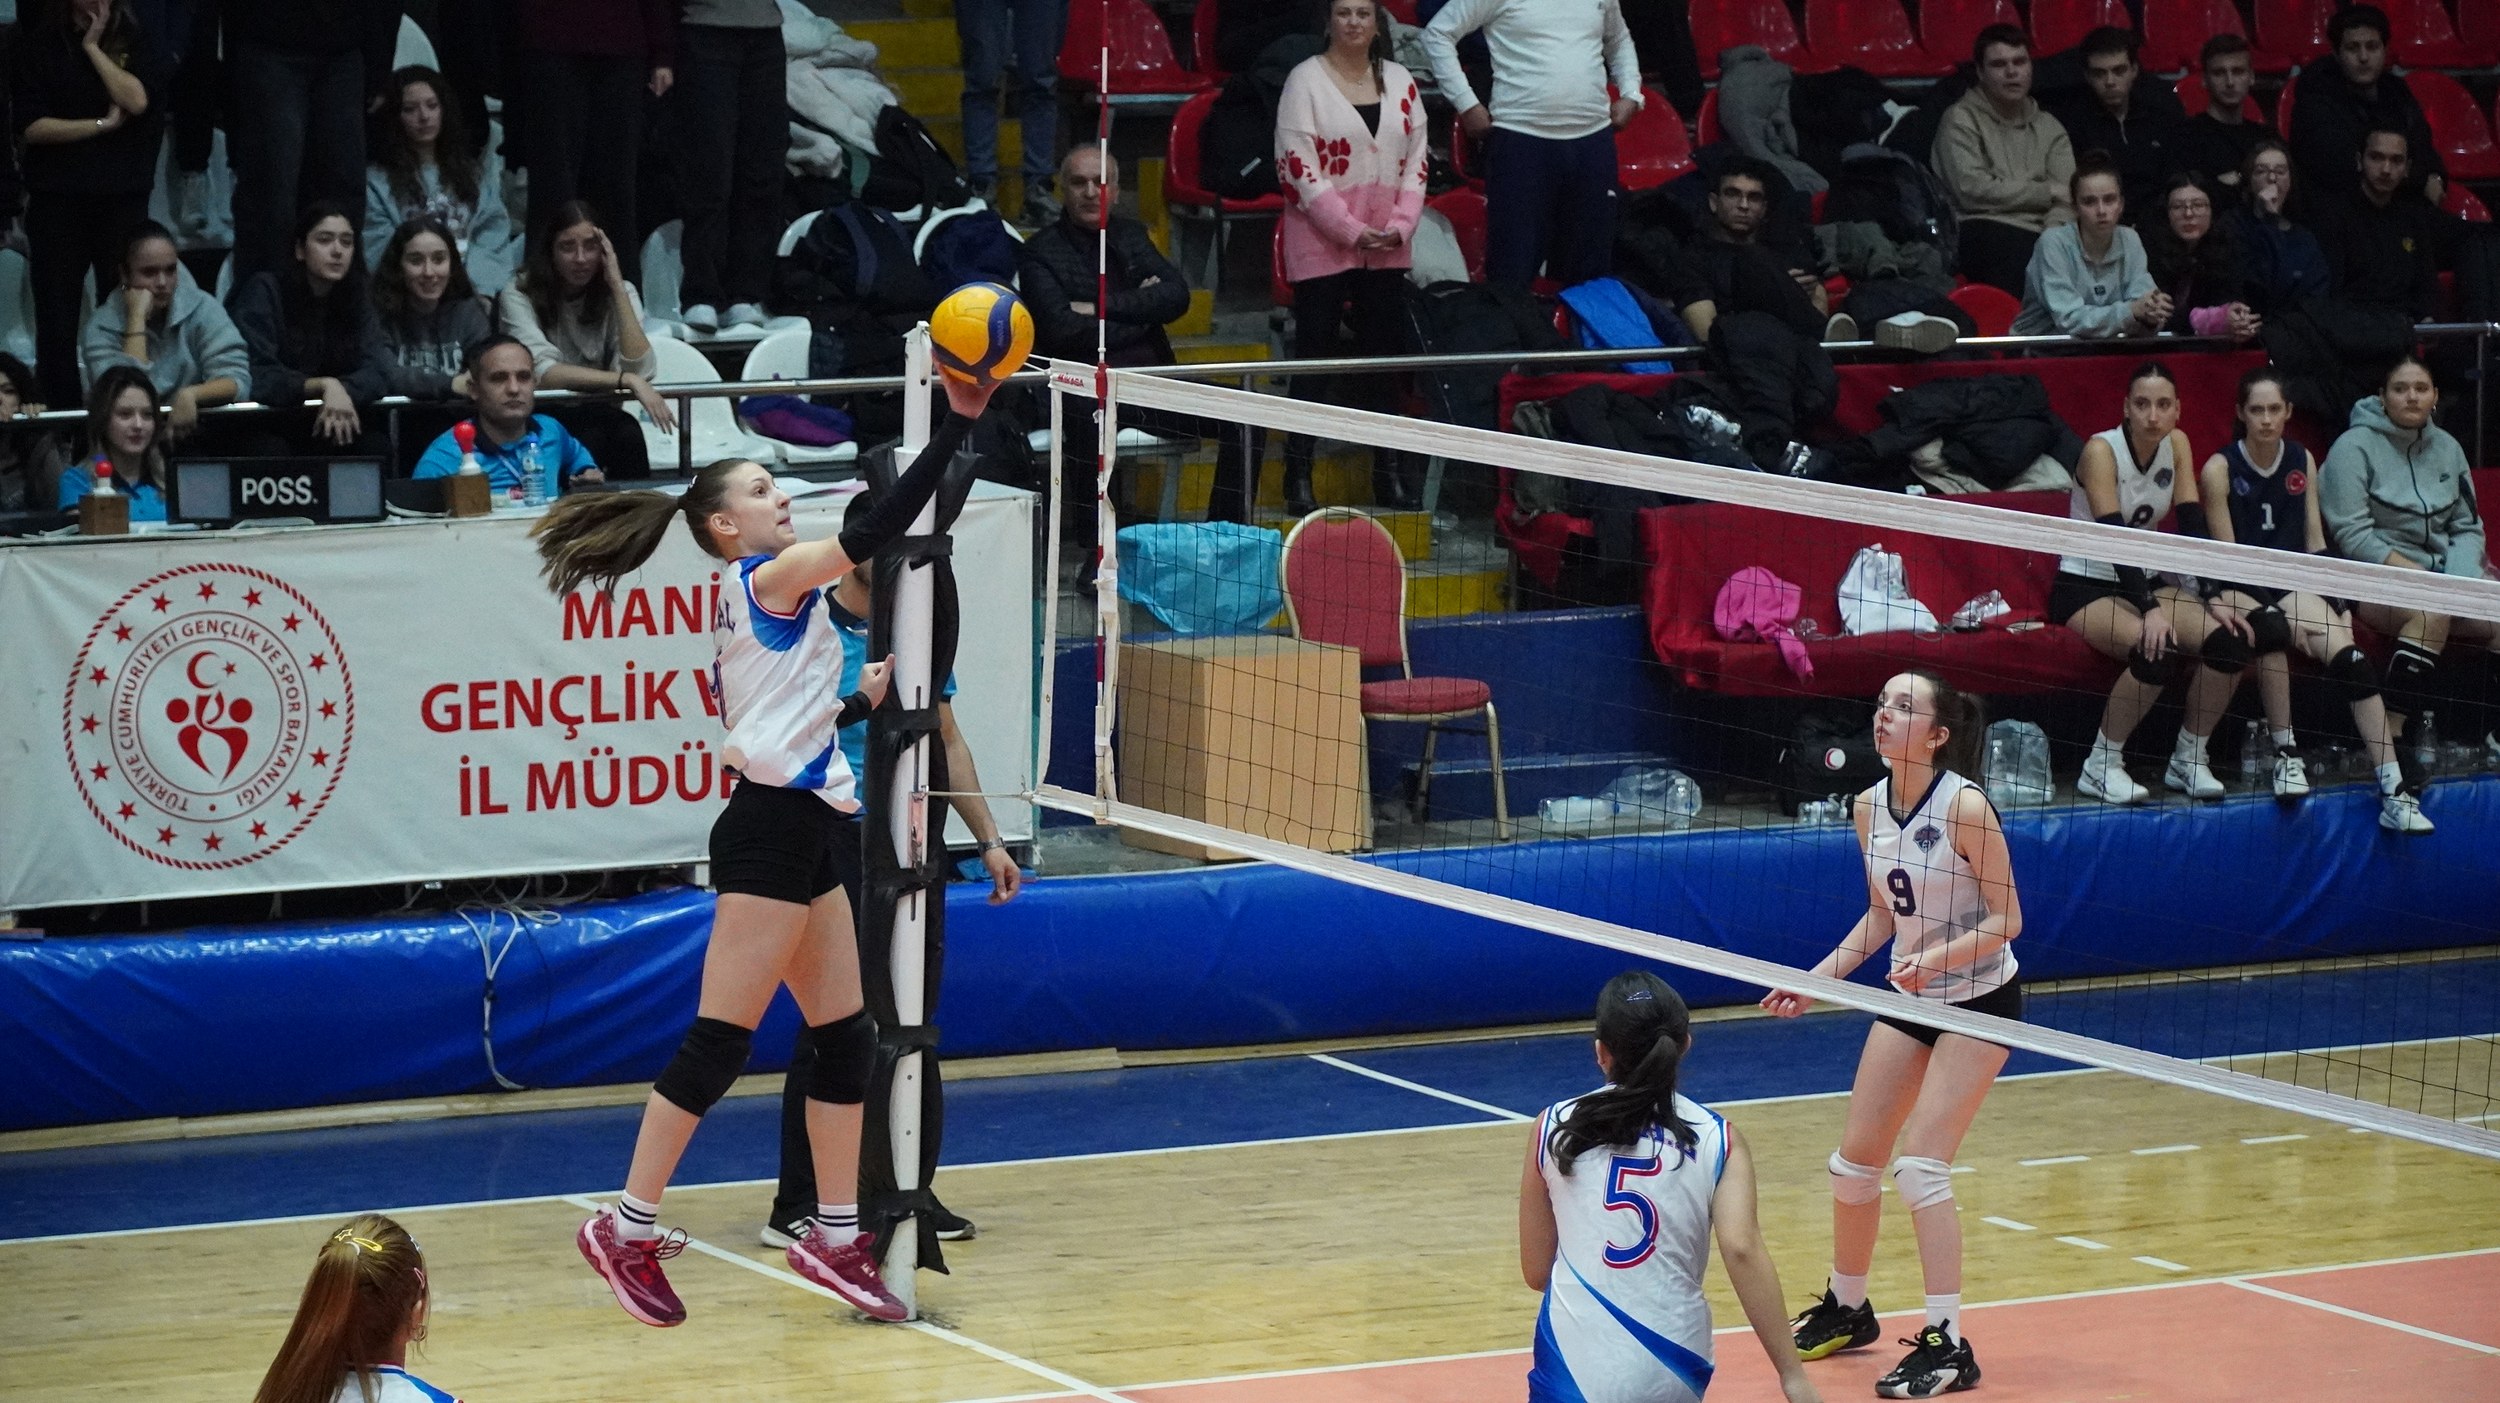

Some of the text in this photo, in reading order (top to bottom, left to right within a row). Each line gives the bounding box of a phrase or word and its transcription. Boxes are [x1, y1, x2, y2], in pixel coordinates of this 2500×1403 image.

[241, 476, 318, 505] POSS.
[2260, 503, 2276, 531] 1
[562, 571, 721, 641] MANİ
[118, 619, 300, 812] TÜRKİYE CUMHURİYETİ GENÇLİK VE SPOR BAKANLIĞI
[421, 660, 681, 740] GENÇLİK
[692, 669, 720, 717] V
[459, 755, 508, 816] İL
[1887, 868, 1916, 916] 9
[1602, 1153, 1662, 1269] 5
